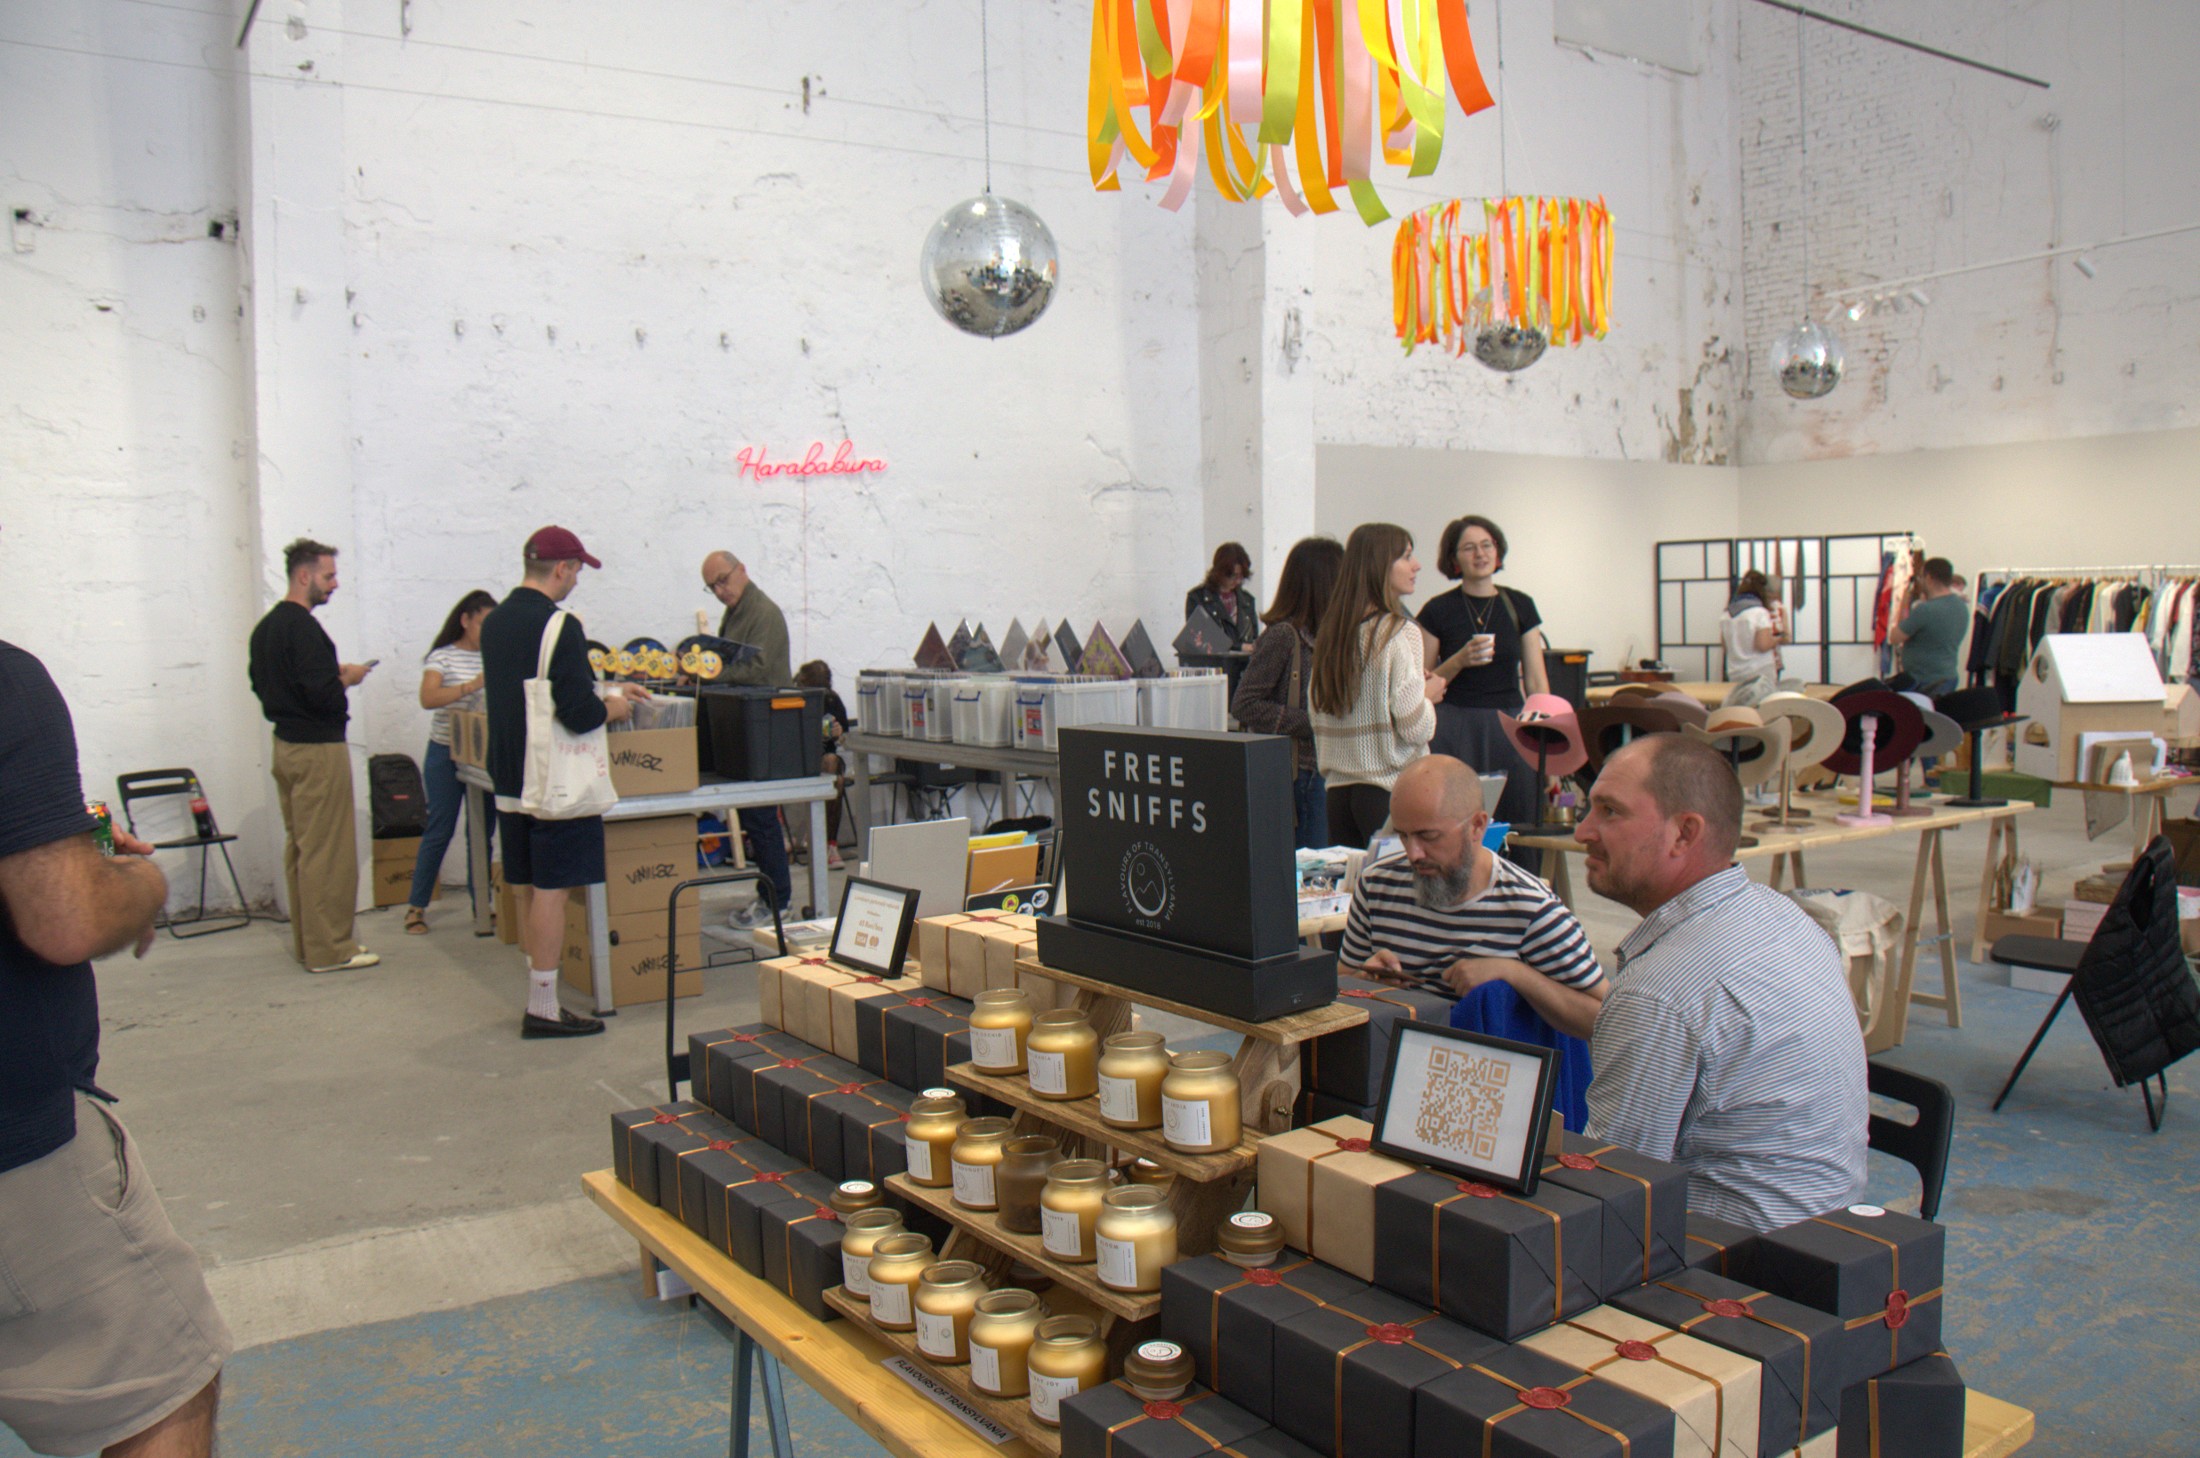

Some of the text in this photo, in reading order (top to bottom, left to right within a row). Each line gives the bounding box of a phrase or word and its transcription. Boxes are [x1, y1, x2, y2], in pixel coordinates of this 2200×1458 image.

[736, 439, 888, 482] Harababura
[1103, 749, 1185, 788] FREE
[1087, 787, 1207, 834] SNIFFS
[1119, 841, 1176, 921] FLAVOURS OF TRANSYLVANIA
[1135, 918, 1145, 927] est
[895, 1360, 1007, 1440] FLAVOURS OF TRANSYLVANIA
